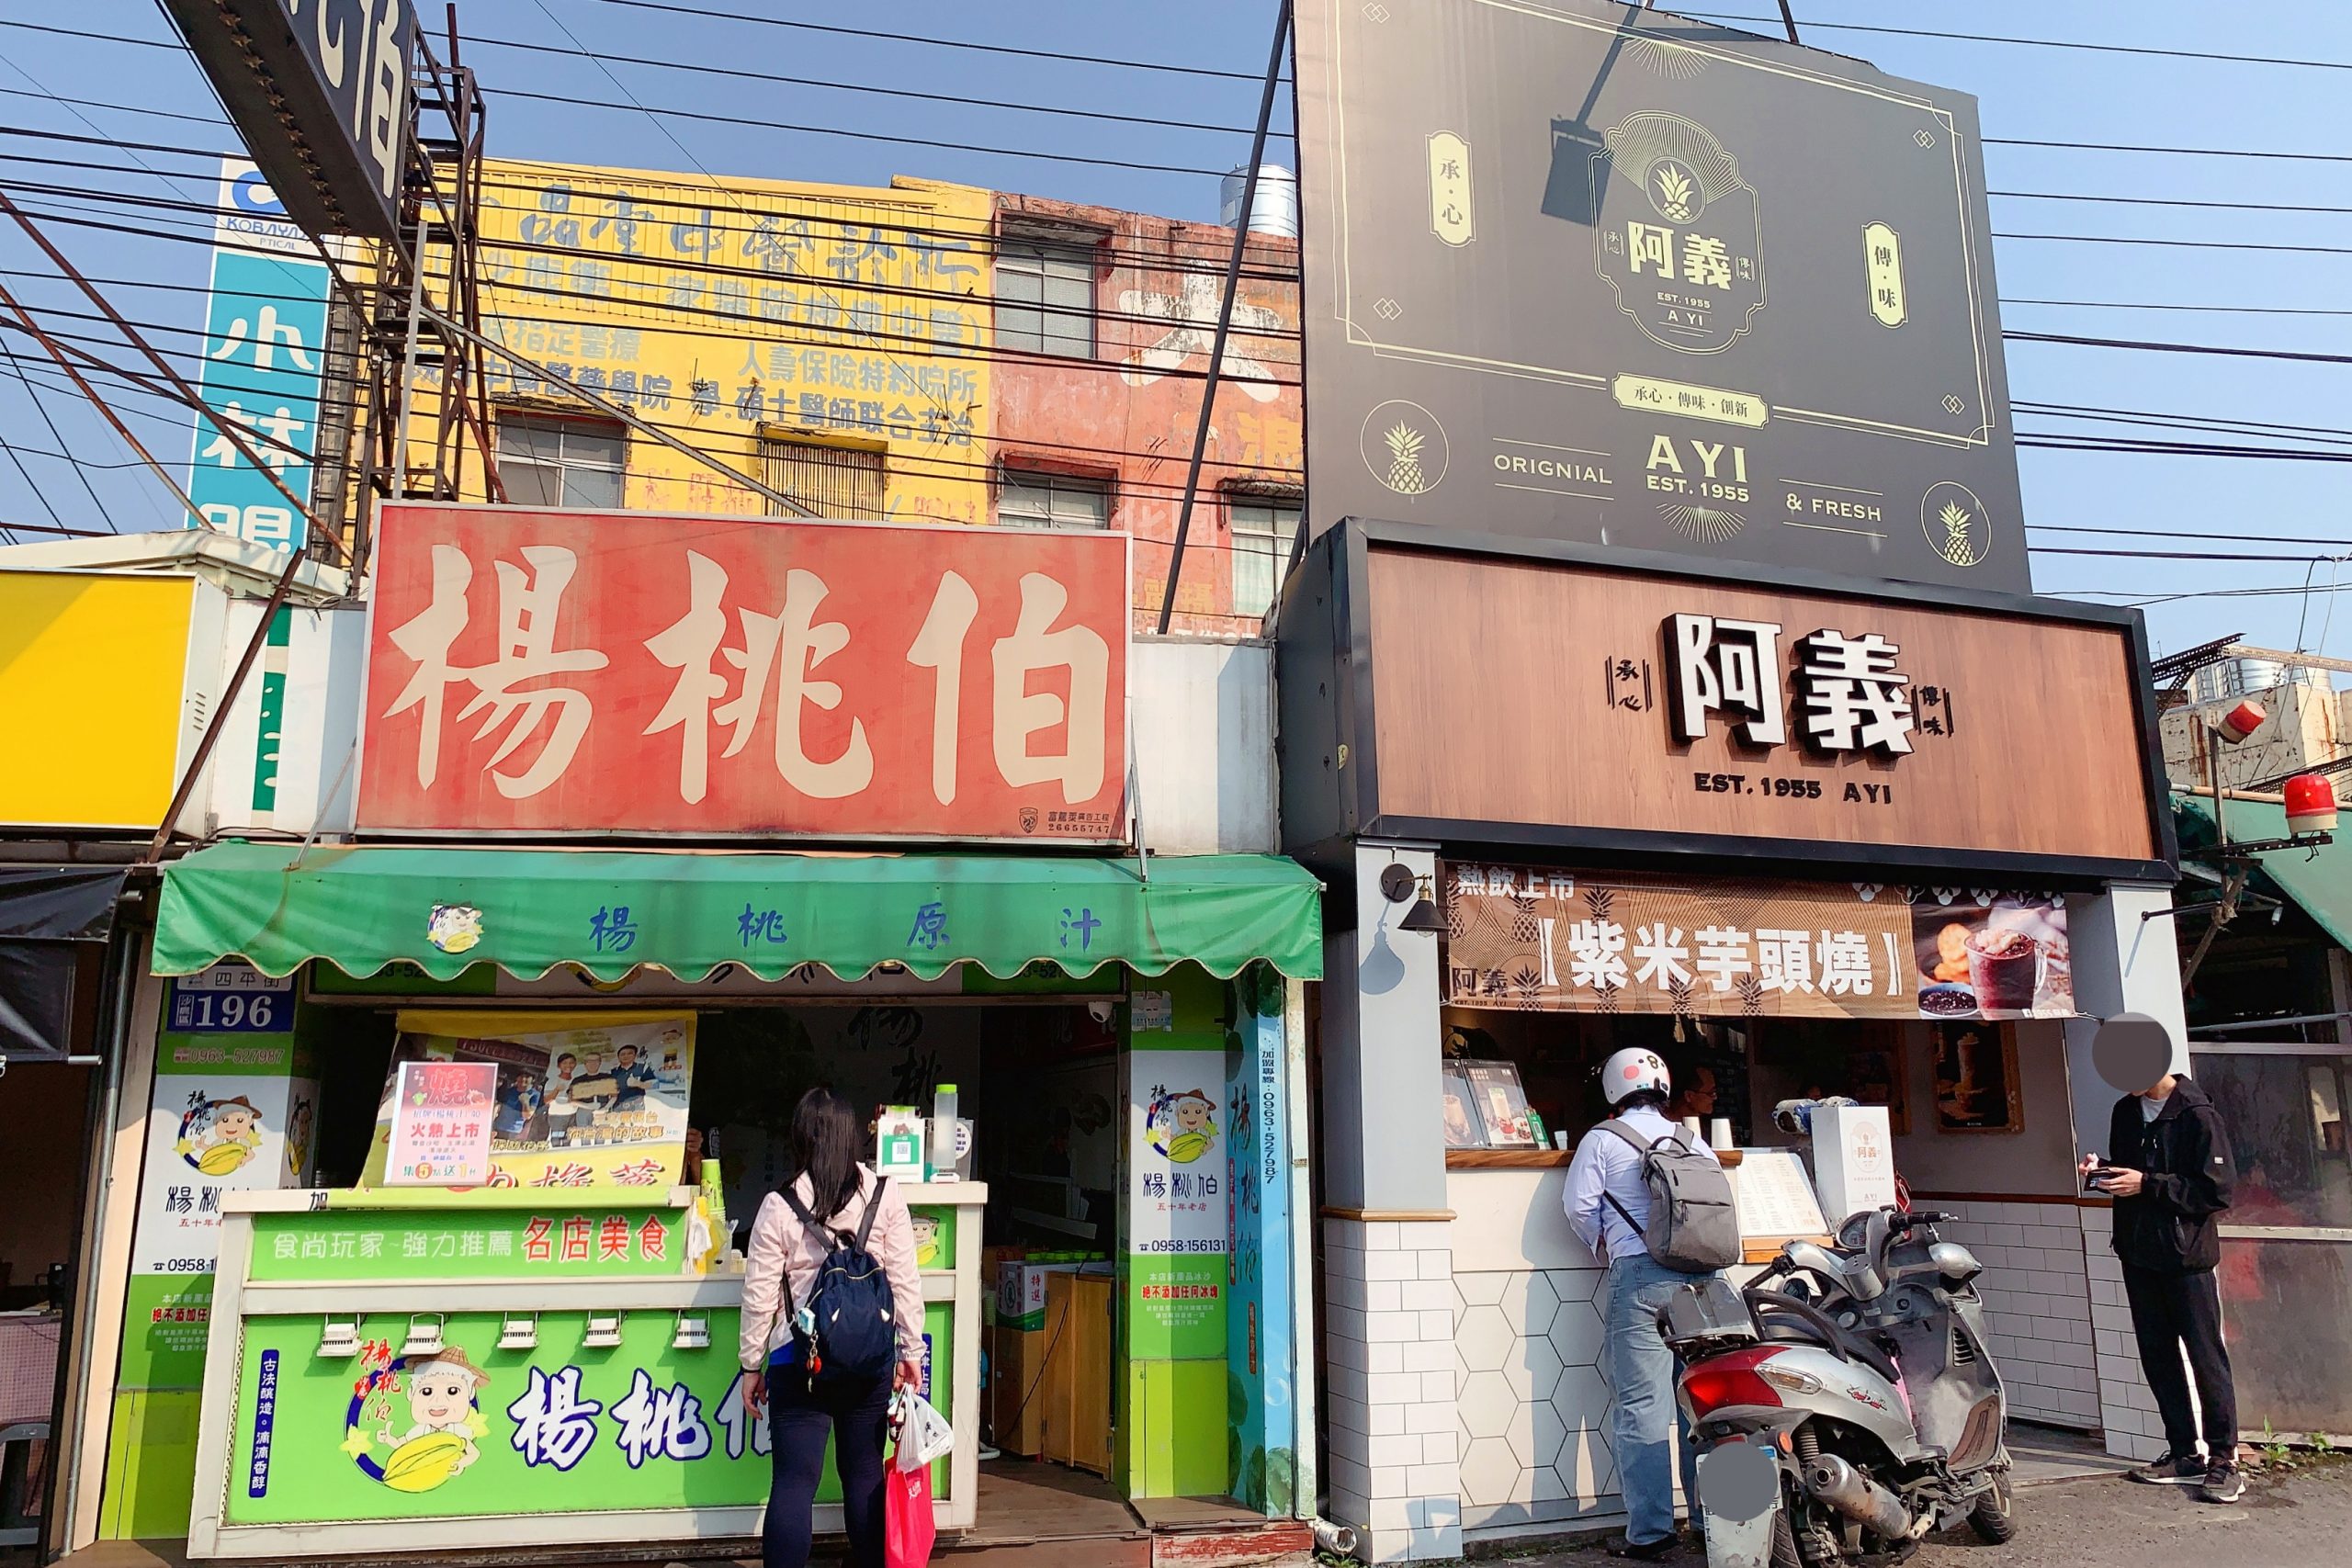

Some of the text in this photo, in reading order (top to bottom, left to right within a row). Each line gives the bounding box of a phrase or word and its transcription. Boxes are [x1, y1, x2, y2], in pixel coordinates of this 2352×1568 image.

[1626, 220, 1732, 290] 阿義
[1657, 291, 1711, 310] EST. 1955
[1493, 454, 1613, 485] ORIGNIAL
[1645, 474, 1749, 503] EST. 1955
[1785, 491, 1882, 522] & FRESH
[381, 543, 1112, 807] 楊桃伯
[1665, 613, 1915, 759] 阿義
[1693, 772, 1894, 806] EST. 1955 AYI
[1457, 866, 1576, 901] 熱飲上市
[588, 897, 1103, 953] 楊桃原汁
[196, 995, 273, 1028] 196
[411, 1122, 481, 1138] 火熱上市
[1157, 1201, 1207, 1213] 五十年老店
[1151, 1239, 1227, 1252] 0958-156131
